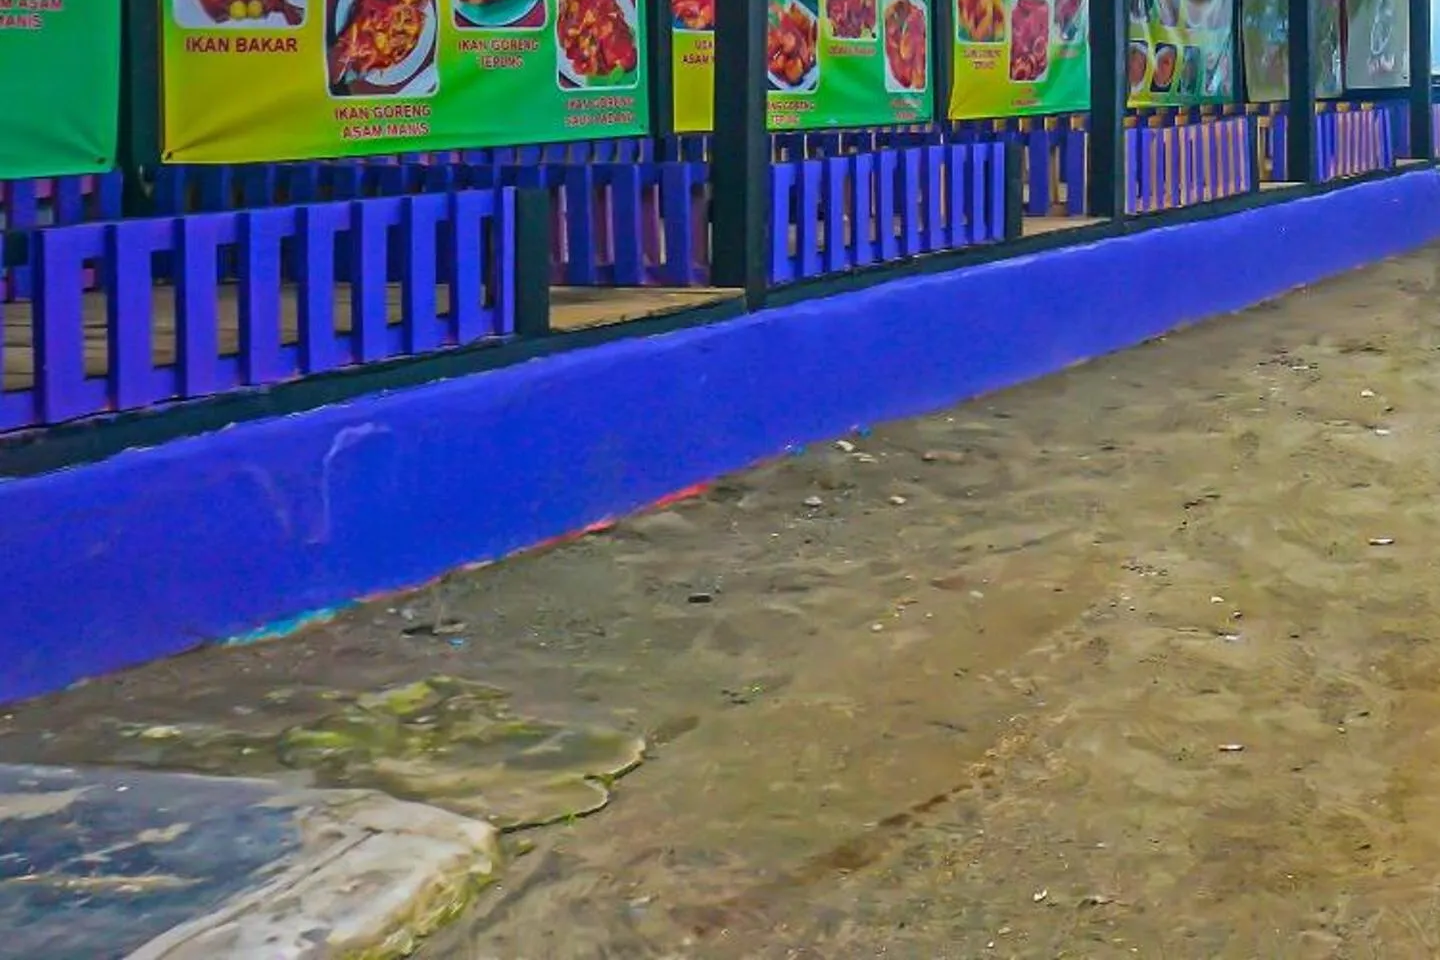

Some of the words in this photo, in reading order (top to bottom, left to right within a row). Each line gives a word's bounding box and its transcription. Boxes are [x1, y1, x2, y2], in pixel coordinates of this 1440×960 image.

[186, 37, 230, 53] IKAN
[236, 36, 298, 53] BAKAR
[458, 39, 487, 52] IKAN
[335, 106, 370, 121] IKAN
[373, 104, 431, 119] GORENG
[343, 125, 382, 138] ASAM
[386, 122, 429, 136] MANIS
